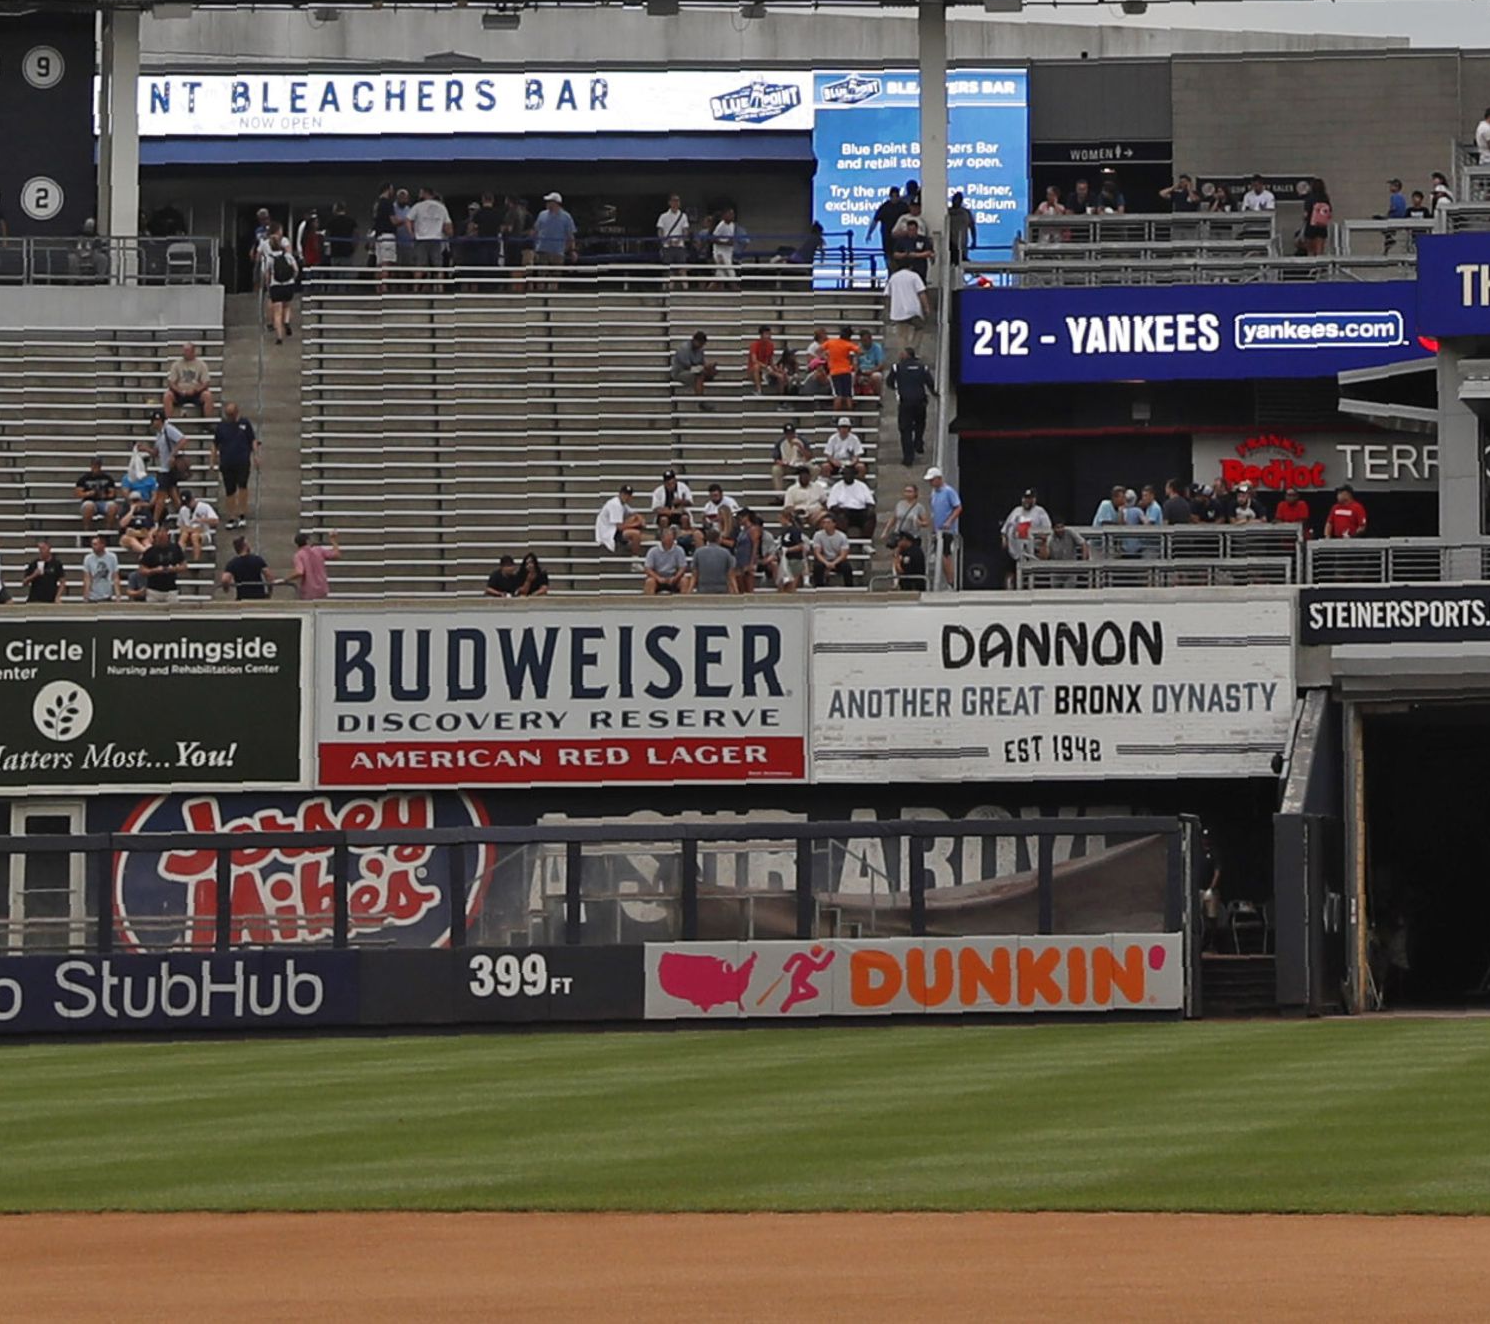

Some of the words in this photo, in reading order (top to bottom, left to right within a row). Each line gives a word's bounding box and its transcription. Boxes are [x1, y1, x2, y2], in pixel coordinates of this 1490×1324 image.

[37, 57, 50, 77] 9
[231, 80, 496, 113] BLEACHERS
[525, 79, 608, 110] BAR
[982, 82, 1015, 94] BAR
[240, 117, 274, 129] NOW
[281, 117, 322, 129] OPEN
[842, 144, 870, 155] Blue
[874, 143, 907, 155] Point
[976, 142, 998, 153] Bar
[1071, 149, 1113, 160] WOMEN
[837, 158, 861, 169] and
[865, 156, 897, 169] retail
[974, 320, 1028, 354] 212
[1066, 314, 1219, 353] YANKEES
[1242, 317, 1395, 346] yankees.com
[6, 640, 82, 661] Circle
[113, 637, 277, 663] Morningside
[941, 621, 1163, 669] DANNON
[107, 666, 147, 676] Nursing
[150, 666, 169, 675] and
[171, 665, 242, 674] Rehabilitation
[245, 664, 279, 673] Center
[334, 625, 784, 702] BUDWEISER
[828, 687, 951, 719] ANOTHER
[961, 686, 1045, 717] GREAT
[1054, 684, 1142, 714] BRONX
[1152, 682, 1278, 713] DYNASTY
[338, 711, 566, 732] DISCOVERY
[591, 709, 779, 729] RESERVE
[351, 749, 541, 768] AMERICAN
[559, 748, 629, 765] RED
[648, 746, 767, 764] LAGER
[1004, 736, 1043, 763] EST
[1052, 736, 1102, 763] 1942
[470, 954, 547, 996] 399
[550, 973, 573, 996] FT
[850, 944, 1167, 1008] DUNKIN'
[55, 960, 322, 1017] StubHub
